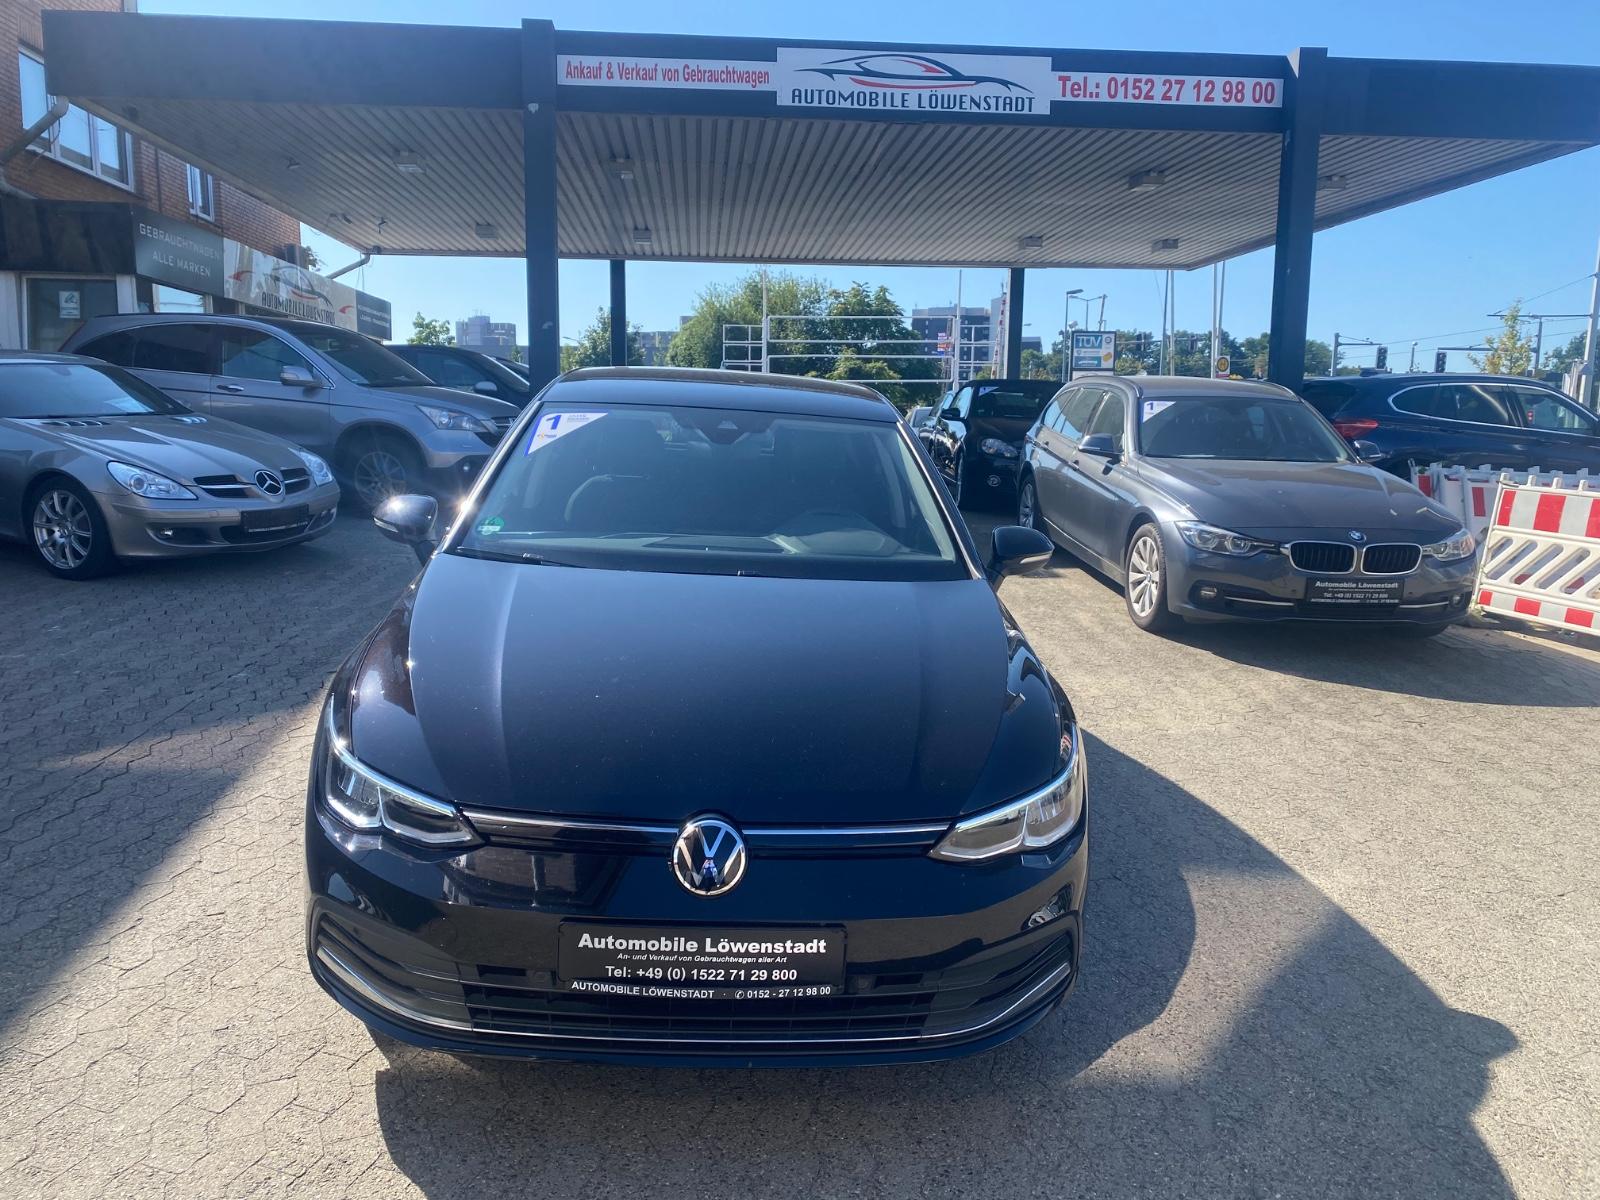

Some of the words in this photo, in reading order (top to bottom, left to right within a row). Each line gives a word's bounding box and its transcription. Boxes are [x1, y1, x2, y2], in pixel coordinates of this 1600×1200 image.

[566, 60, 602, 80] Ankauf
[606, 62, 614, 80] &
[618, 62, 658, 81] Verkauf
[662, 68, 679, 82] von
[682, 64, 770, 88] Gebrauchtwagen
[1058, 76, 1100, 98] Tel.:
[1107, 76, 1155, 100] 0152
[1161, 79, 1185, 102] 27
[1192, 80, 1216, 102] 12
[1222, 80, 1246, 103] 98
[1252, 82, 1276, 104] 00
[792, 88, 910, 108] AUTOMOBILE
[918, 90, 1035, 112] LÖWENSTADT
[152, 250, 174, 266] ALLE
[177, 258, 210, 278] MARKEN
[546, 415, 562, 430] 1
[578, 934, 698, 952] Automobile
[705, 938, 826, 953] Löwenstadt
[694, 955, 756, 964] Gebrauchtwagen
[605, 966, 631, 978] Tel:
[636, 968, 662, 979] +49
[667, 967, 686, 981] (0)
[691, 969, 725, 980] 1522
[730, 970, 745, 980] 71
[751, 970, 768, 980] 29
[772, 970, 798, 980] 800
[572, 982, 640, 995] AUTOMOBILE
[643, 987, 714, 998] LÖWENSTADT
[747, 990, 770, 998] 0152
[779, 989, 790, 998] 27
[820, 987, 831, 995] 00
